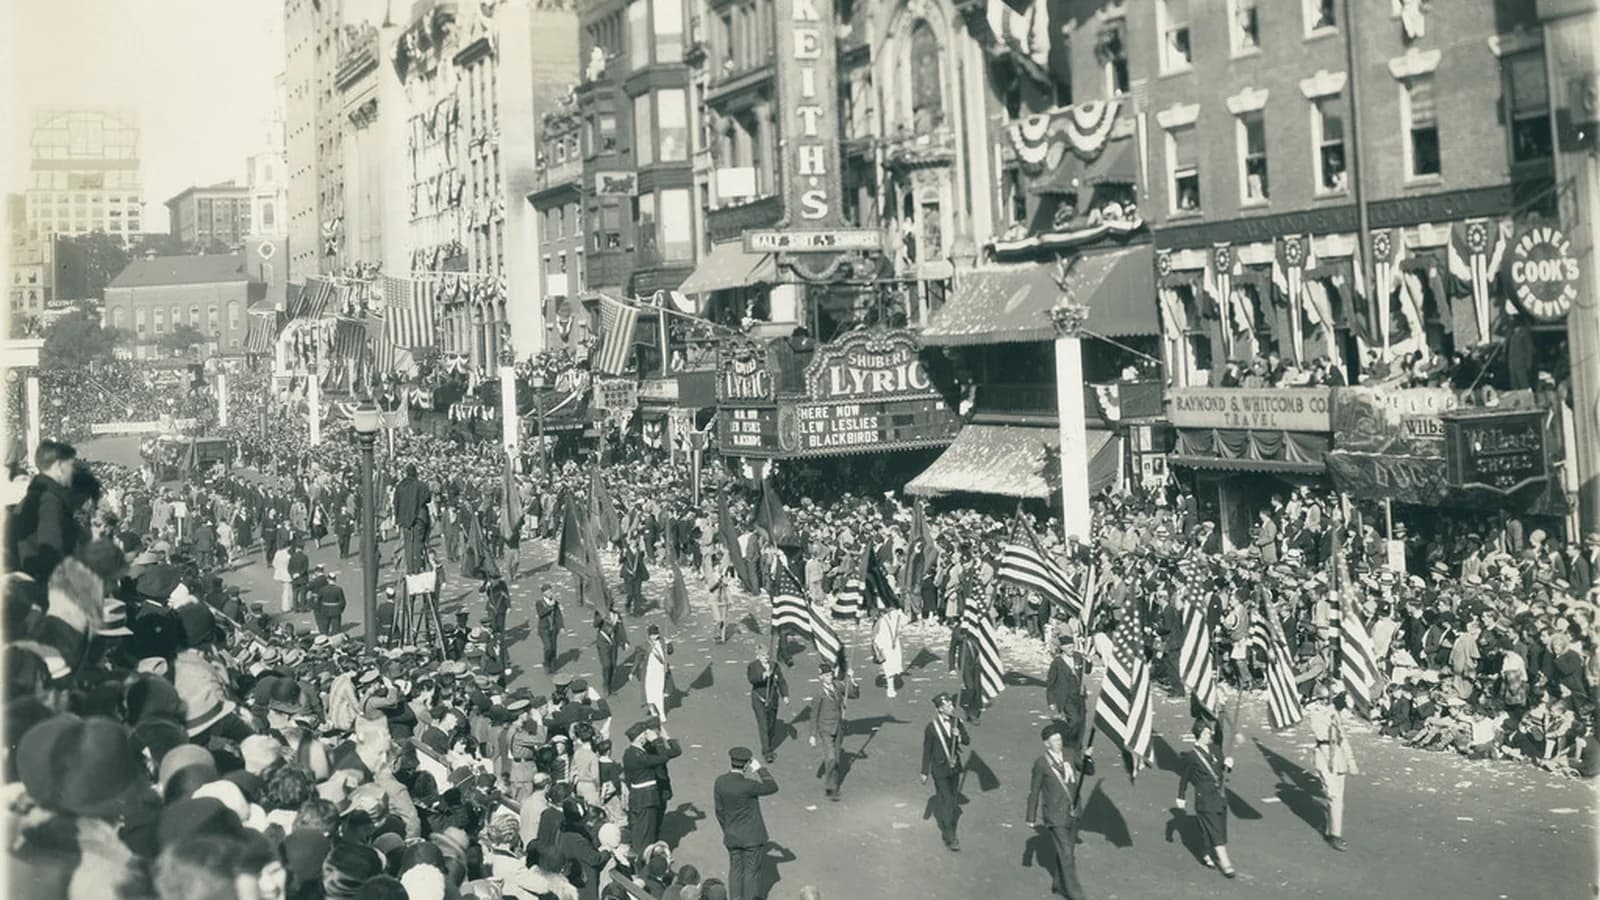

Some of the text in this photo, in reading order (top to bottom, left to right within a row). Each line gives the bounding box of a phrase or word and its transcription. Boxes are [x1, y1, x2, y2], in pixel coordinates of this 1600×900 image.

[1515, 227, 1570, 257] TRAVEL
[1511, 257, 1580, 283] COOK'S
[1517, 283, 1577, 317] SERVICE
[829, 360, 931, 396] LYRIC
[800, 405, 861, 419] HERE NOW
[1176, 396, 1226, 411] RAYMOND
[1230, 396, 1240, 411] &
[1242, 398, 1305, 413] WHITCOMB
[802, 417, 878, 434] LEW LESLIES
[1224, 413, 1277, 426] TRAVEL
[809, 430, 879, 448] BLACKBIRDS
[1476, 455, 1533, 473] SHOES
